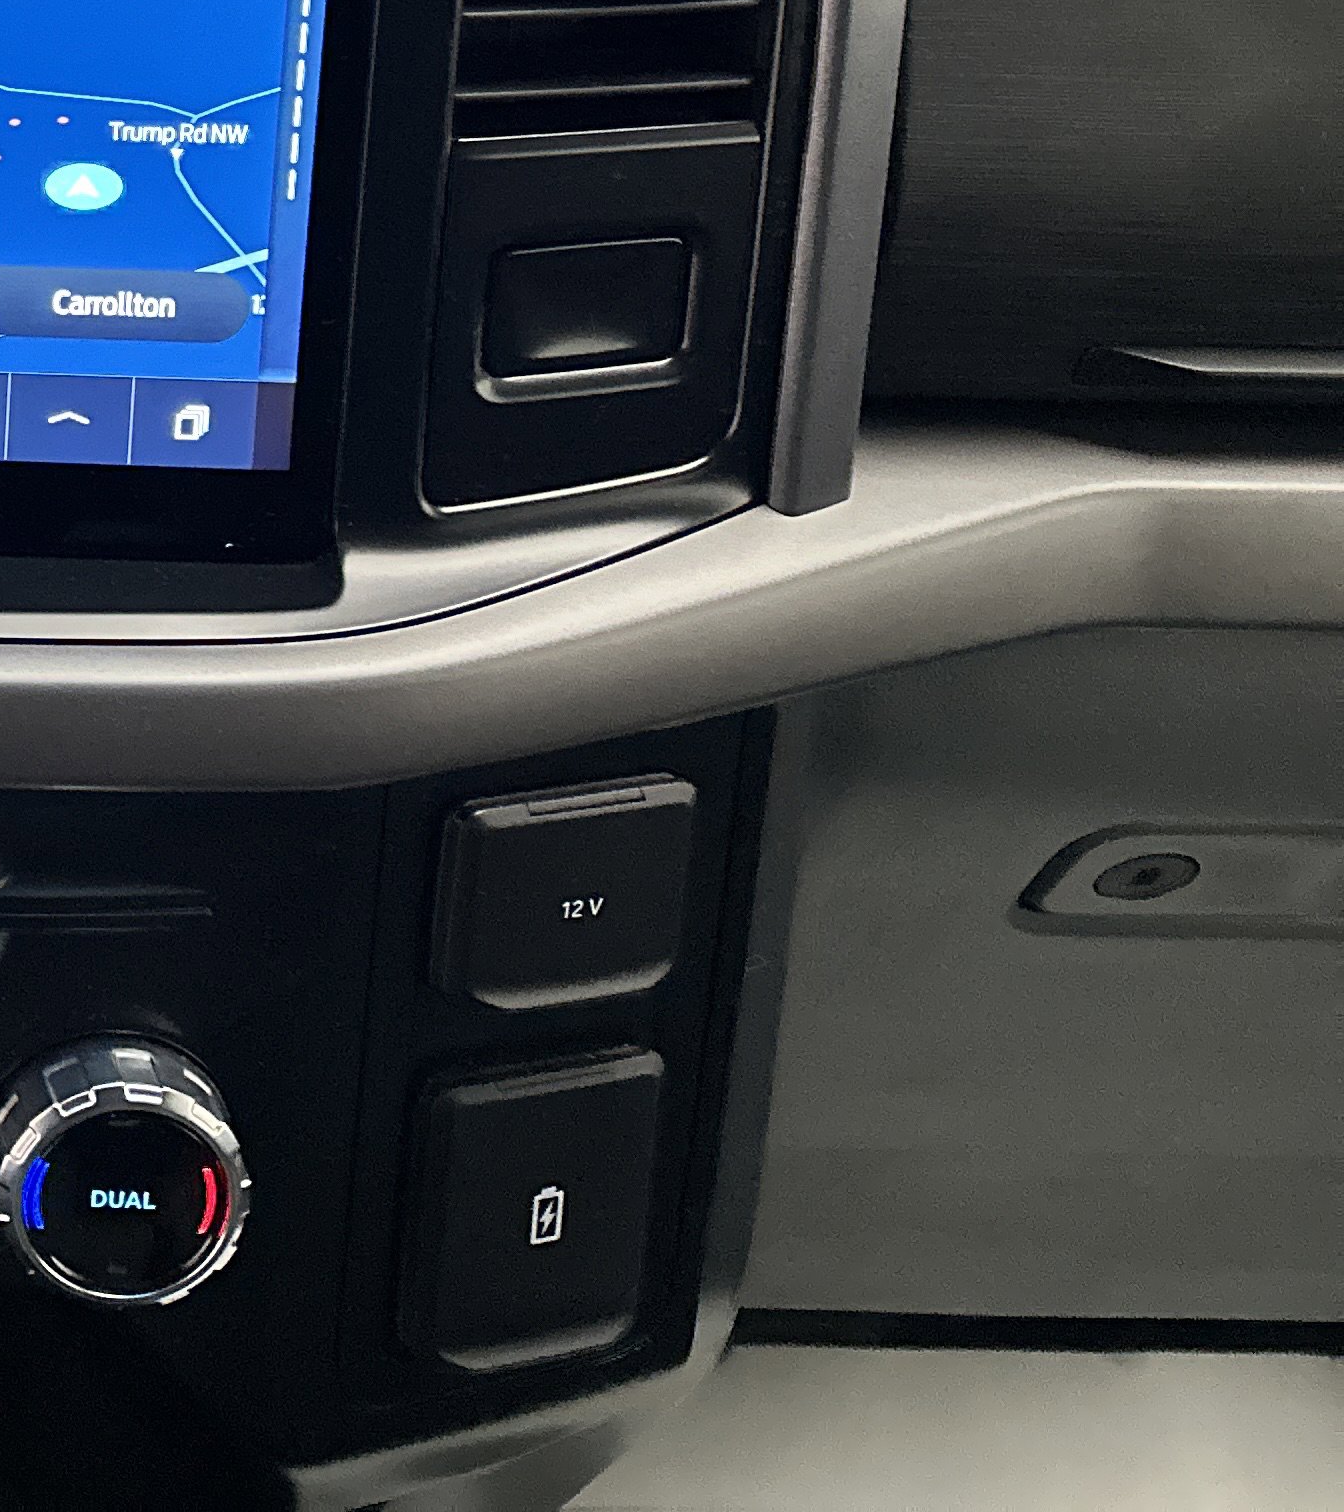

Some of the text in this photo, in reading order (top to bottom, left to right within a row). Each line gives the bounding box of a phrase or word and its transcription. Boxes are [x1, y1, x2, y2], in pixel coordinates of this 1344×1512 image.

[108, 121, 249, 146] Trump Rd NW
[52, 290, 176, 320] Carrollton
[561, 896, 605, 920] 12 V
[90, 1189, 157, 1212] DUAL
